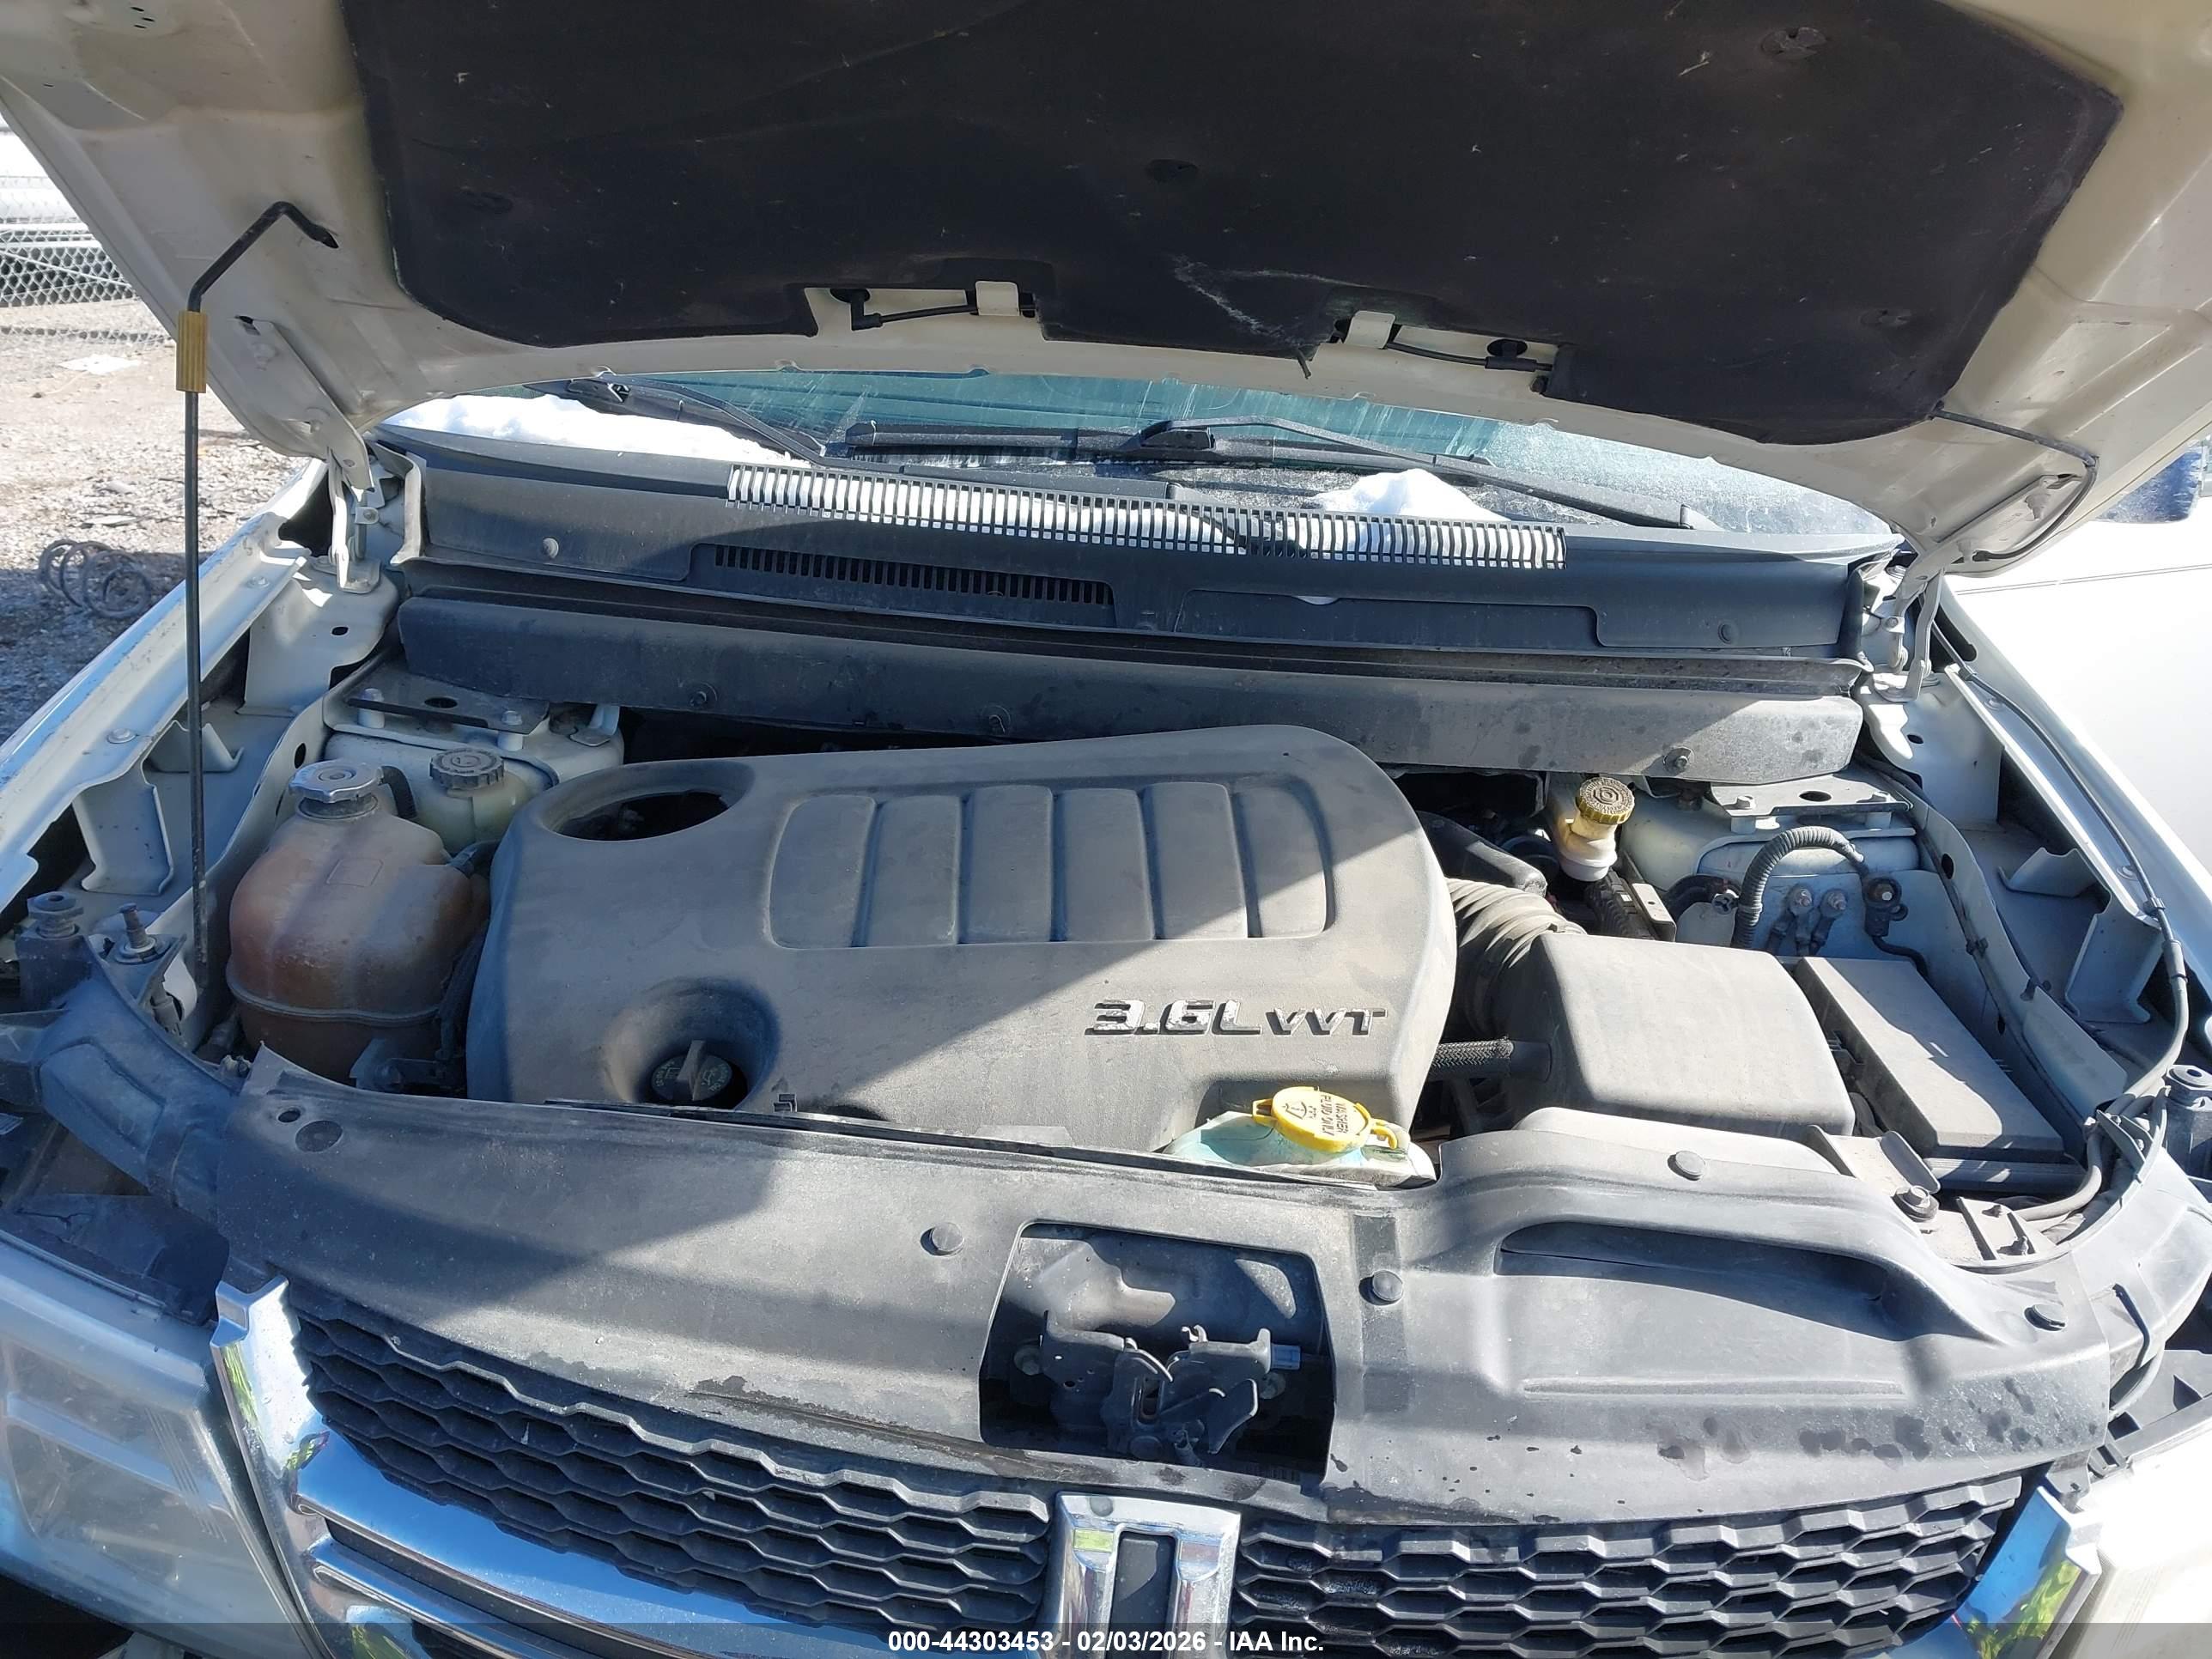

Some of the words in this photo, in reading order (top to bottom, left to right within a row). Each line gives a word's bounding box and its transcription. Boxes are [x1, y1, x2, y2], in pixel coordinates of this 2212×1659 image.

[1085, 999, 1262, 1036] 3.6L
[1265, 1007, 1388, 1036] VVT
[1320, 1094, 1333, 1115] FLUID
[1321, 1116, 1334, 1136] ONLY
[1334, 1103, 1349, 1133] WASHER
